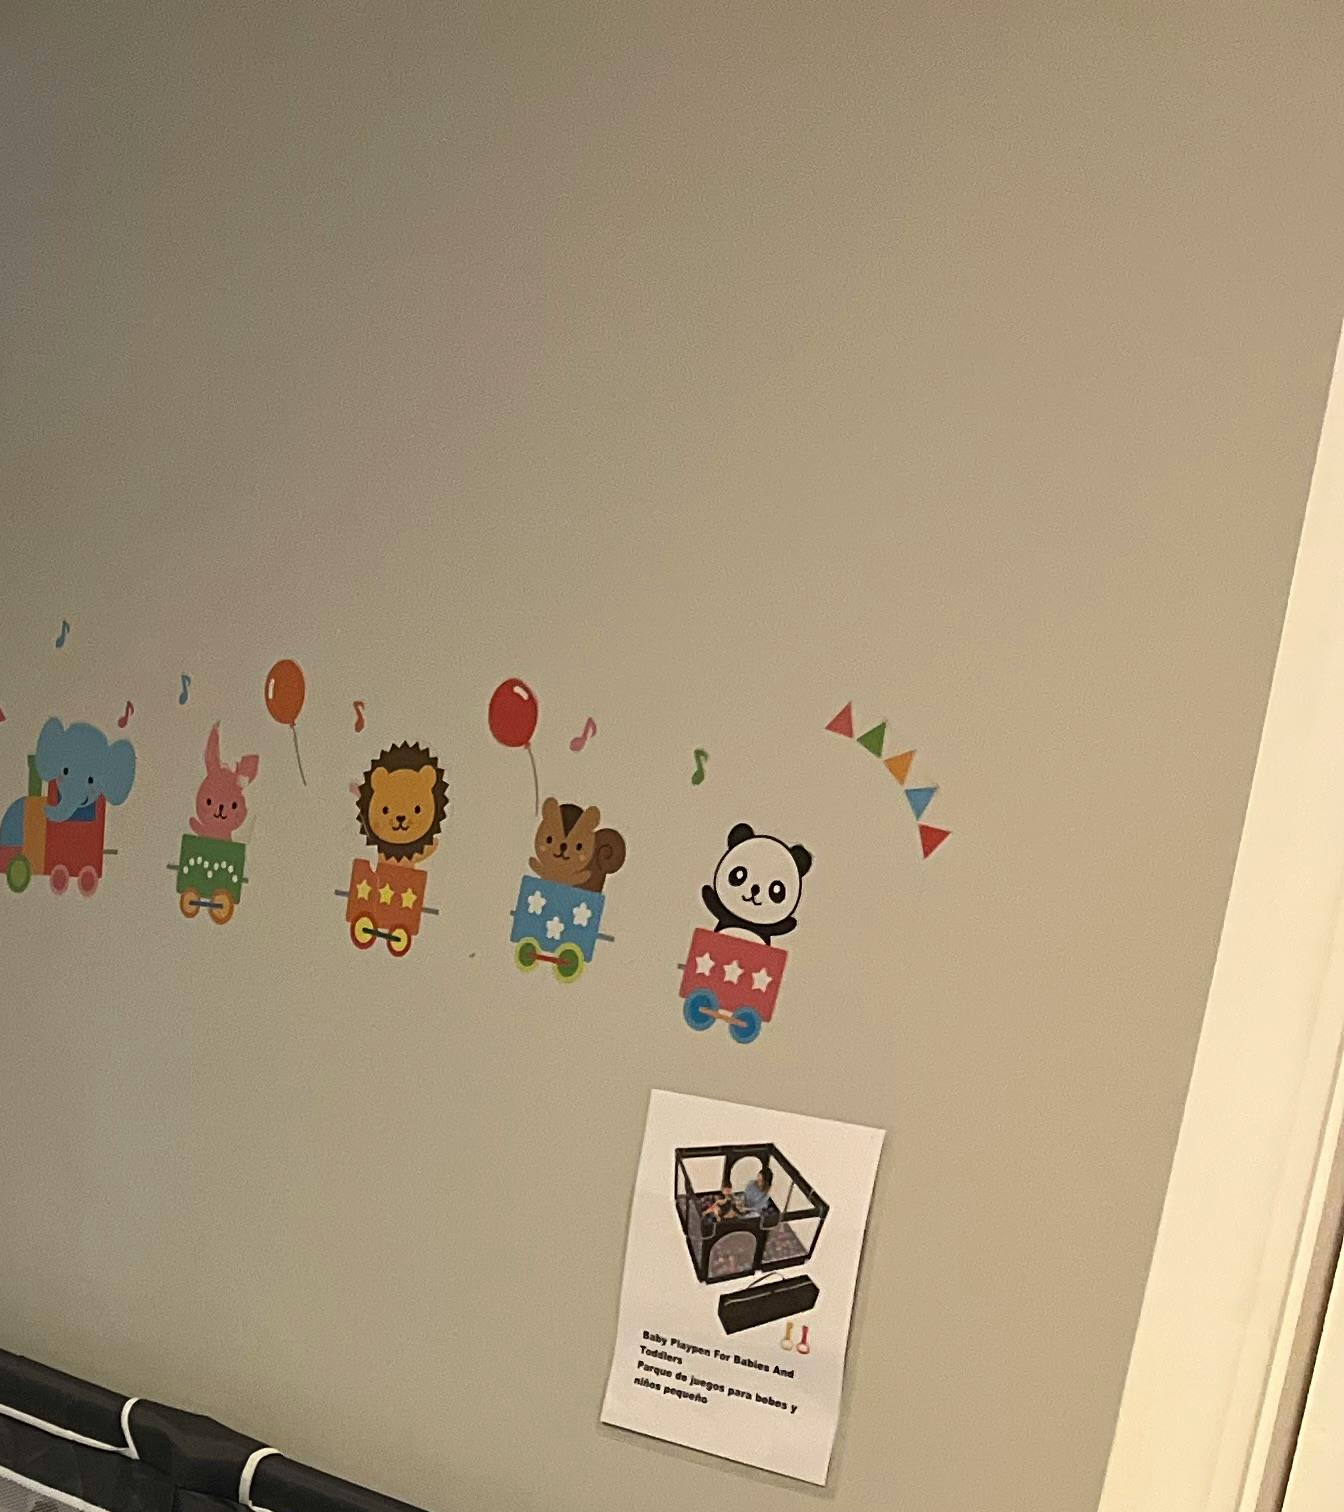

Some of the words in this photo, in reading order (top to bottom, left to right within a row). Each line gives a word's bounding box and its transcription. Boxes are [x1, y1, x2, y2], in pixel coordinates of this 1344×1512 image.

[639, 1345, 683, 1364] Toddlers
[642, 1330, 667, 1346] Baby
[670, 1337, 710, 1356] Playpen
[713, 1349, 731, 1362] For
[733, 1354, 770, 1372] Babies
[772, 1365, 795, 1378] And
[633, 1376, 661, 1391] niños
[663, 1385, 708, 1403] pequeño
[637, 1360, 672, 1377] Parque
[674, 1372, 687, 1382] de
[689, 1375, 724, 1392] juegos
[727, 1387, 752, 1400] para
[755, 1392, 787, 1410] bebes
[790, 1404, 798, 1414] y
